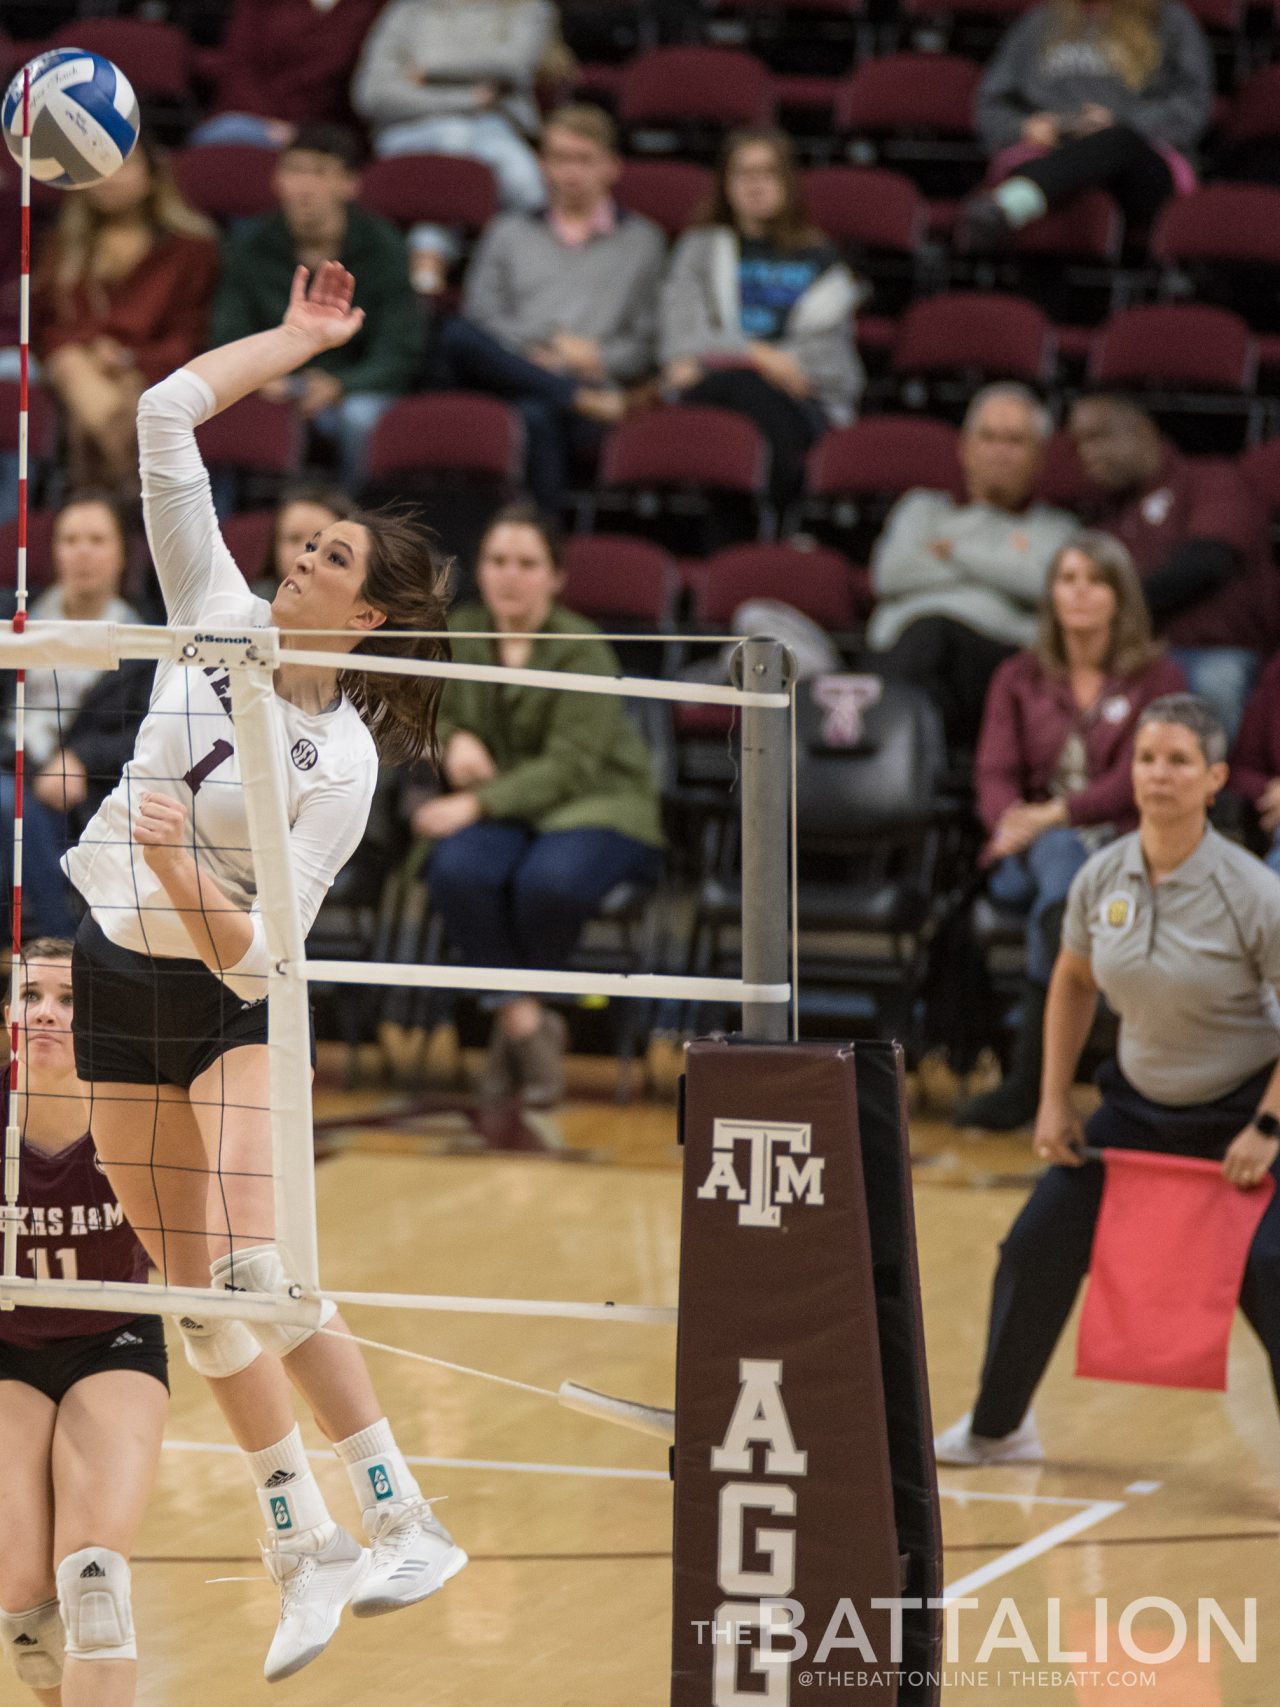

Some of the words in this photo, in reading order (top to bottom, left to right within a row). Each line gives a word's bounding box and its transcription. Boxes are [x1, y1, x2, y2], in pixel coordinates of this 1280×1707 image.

[183, 738, 235, 796] 1
[71, 1202, 125, 1236] A&M
[26, 1247, 78, 1281] 11
